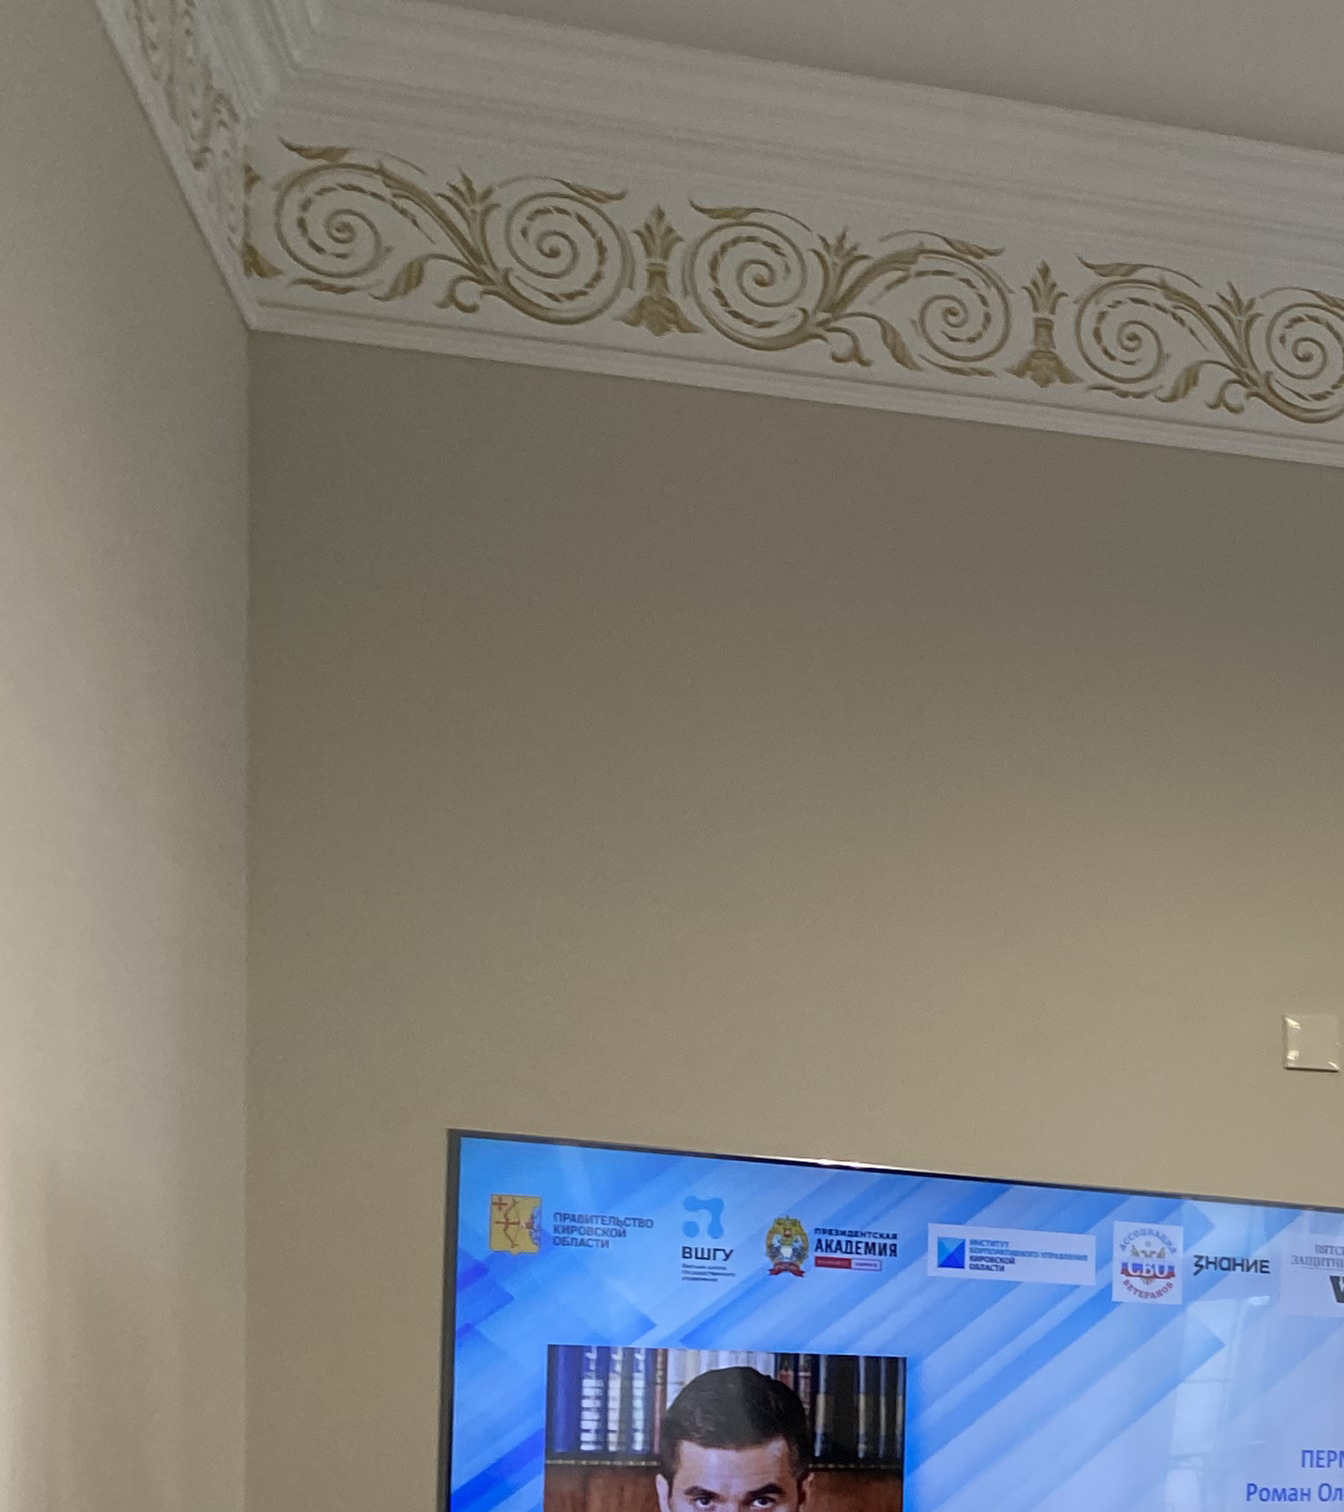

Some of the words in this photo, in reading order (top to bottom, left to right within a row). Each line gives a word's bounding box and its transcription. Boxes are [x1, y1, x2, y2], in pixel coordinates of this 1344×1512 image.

[553, 1212, 654, 1228] ПРАВИТЕЛЬСТВО
[553, 1224, 627, 1238] КИРОВСКОЙ
[814, 1228, 898, 1240] ПРЕЗИДЕНТСКАЯ
[553, 1236, 610, 1248] ОБЛАСТИ
[814, 1238, 898, 1257] АКАДЕМИЯ
[681, 1246, 735, 1261] ВШГУ
[1122, 1279, 1174, 1299] ВЕТЕРАНОВ
[1246, 1484, 1311, 1502] Роман
